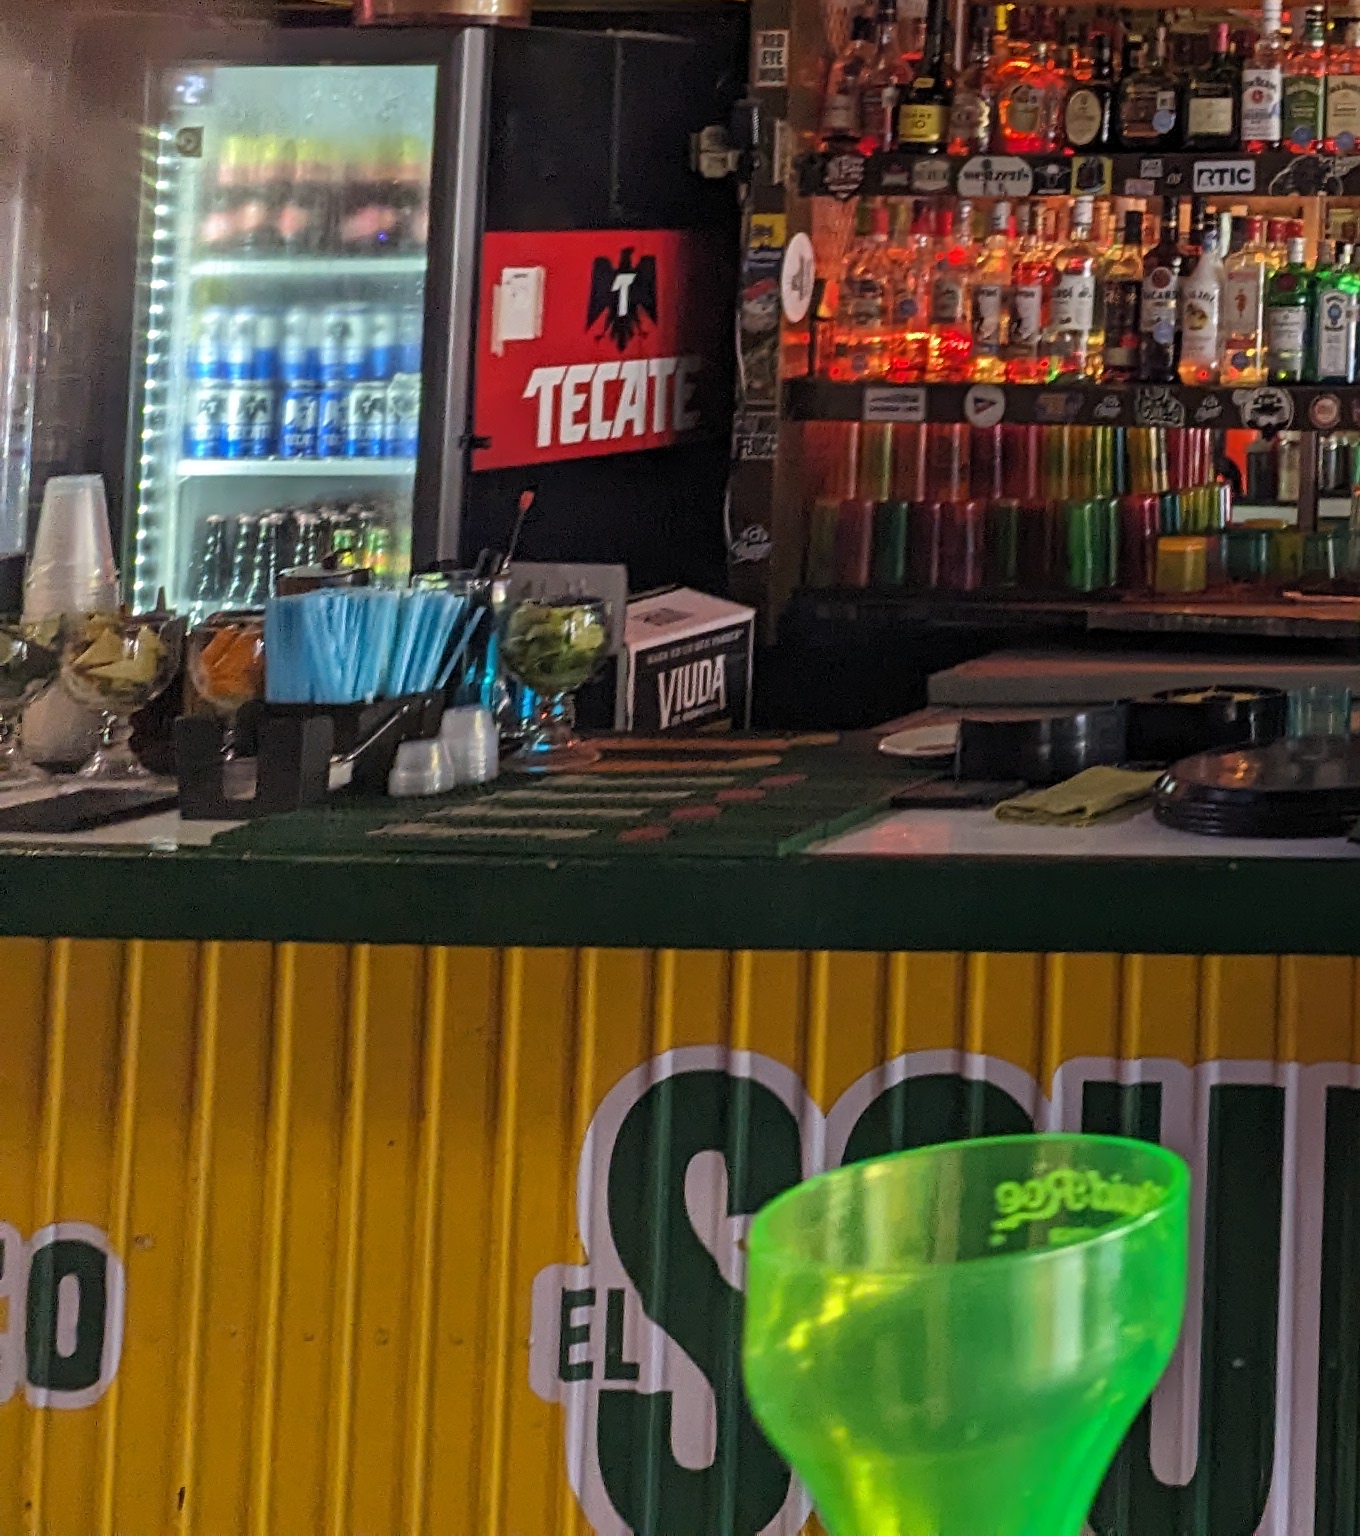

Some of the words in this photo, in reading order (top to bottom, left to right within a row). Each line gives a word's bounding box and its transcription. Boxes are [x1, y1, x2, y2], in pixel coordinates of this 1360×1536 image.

[1197, 167, 1254, 188] RTIC
[522, 357, 698, 449] TECATE
[656, 653, 728, 729] VIUDA
[556, 1284, 645, 1384] EL
